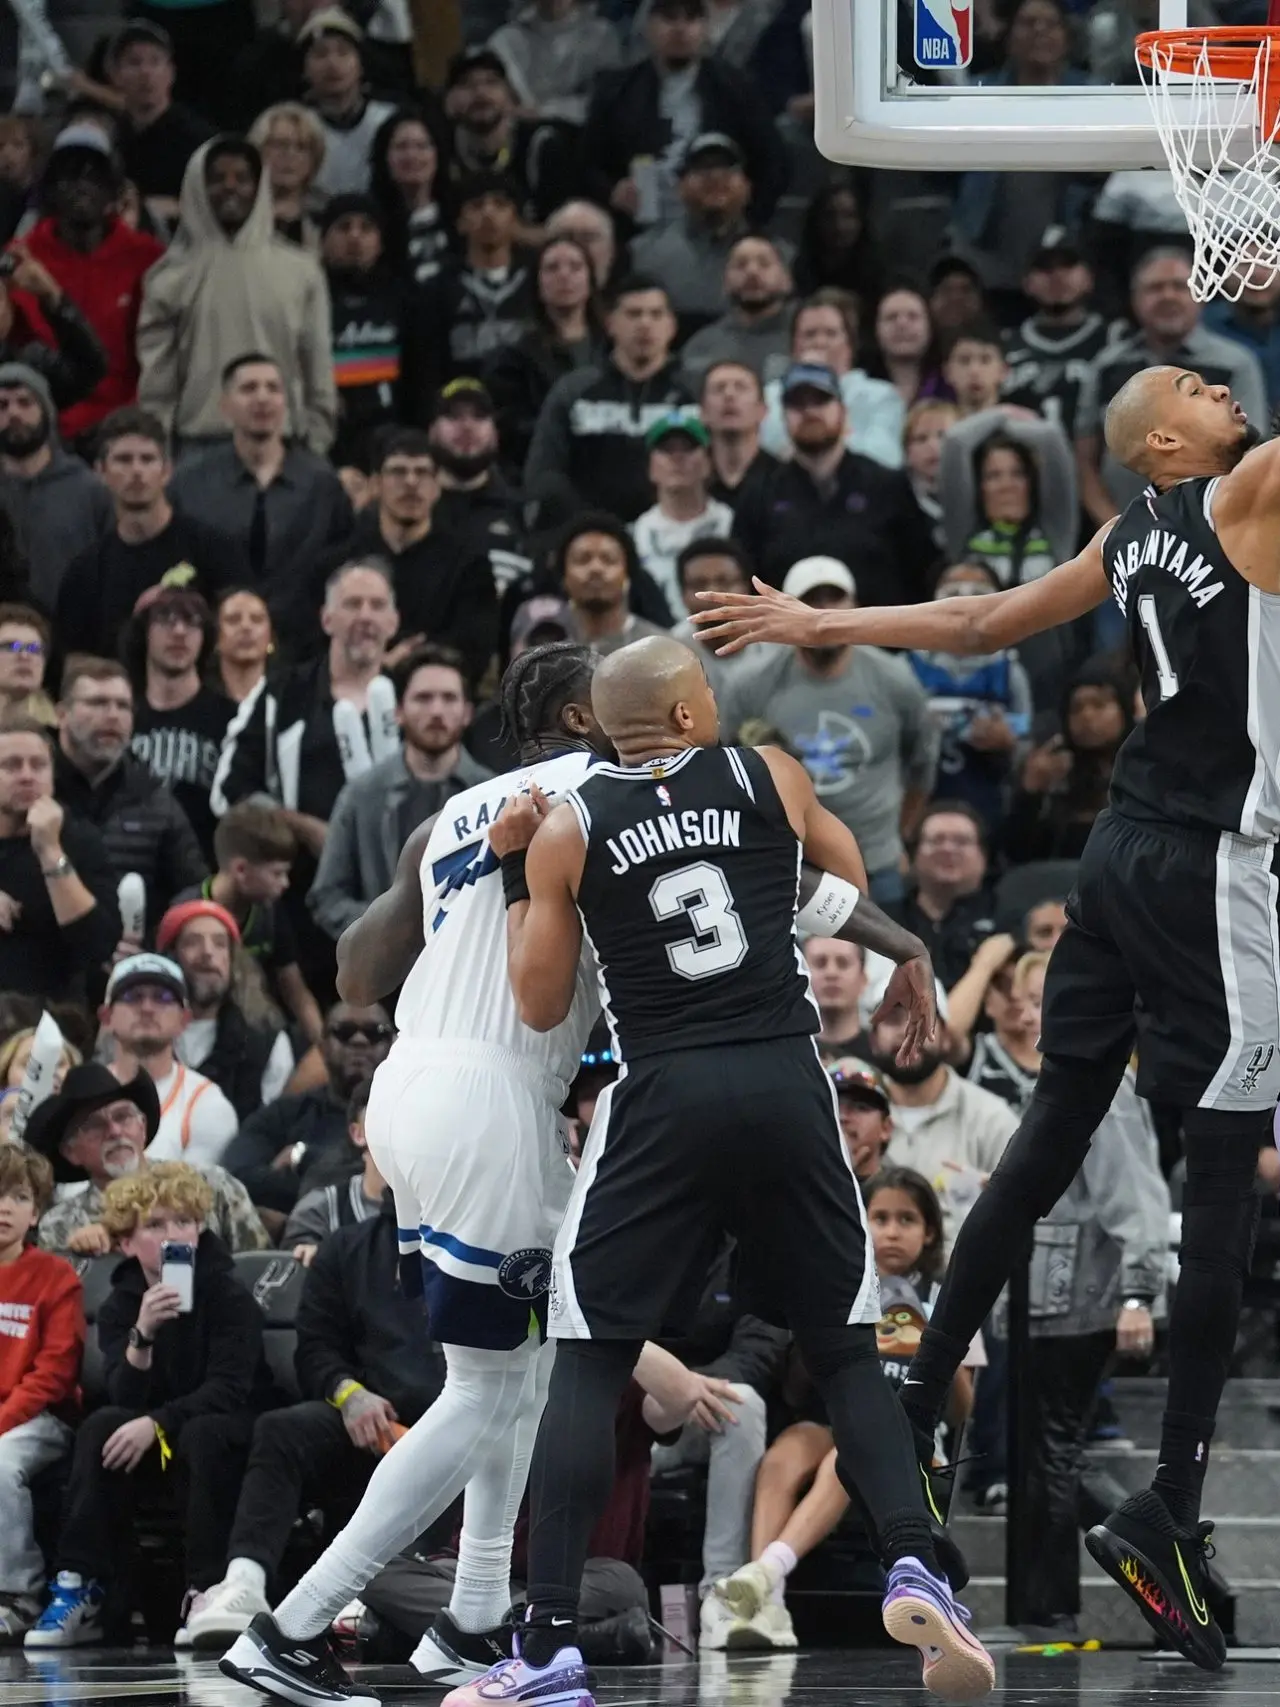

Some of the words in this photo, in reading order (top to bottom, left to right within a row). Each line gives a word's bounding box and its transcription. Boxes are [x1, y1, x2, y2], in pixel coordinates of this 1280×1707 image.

[922, 37, 950, 60] NBA
[1112, 529, 1226, 619] EMBNYAMA
[1137, 594, 1180, 702] 1
[605, 808, 741, 875] JOHNSON
[648, 860, 749, 981] 3
[815, 891, 836, 916] Kyden
[828, 897, 847, 924] Jayce
